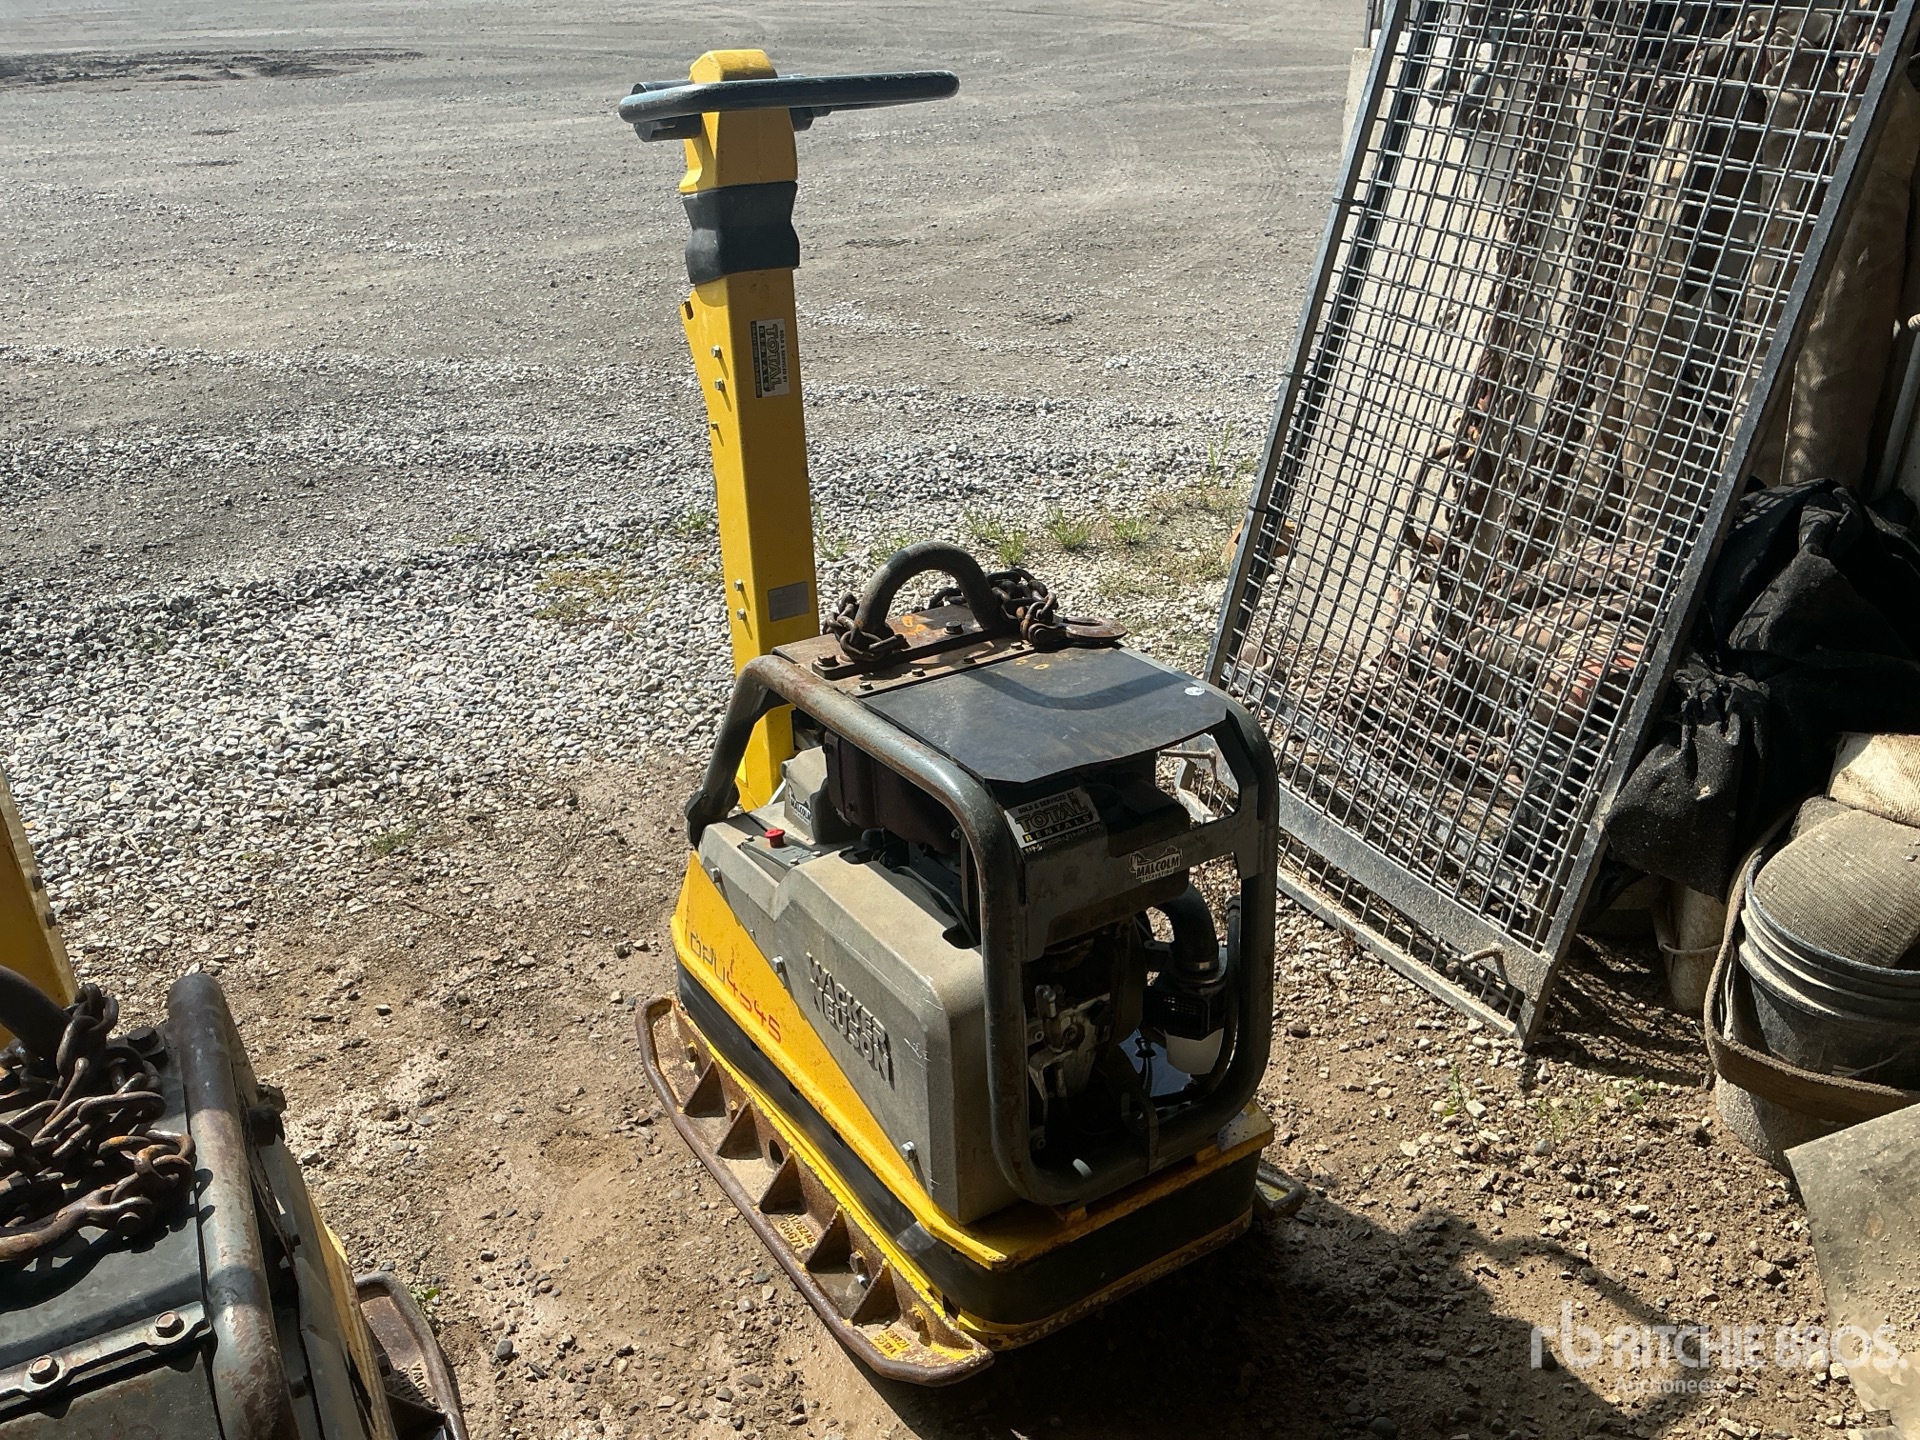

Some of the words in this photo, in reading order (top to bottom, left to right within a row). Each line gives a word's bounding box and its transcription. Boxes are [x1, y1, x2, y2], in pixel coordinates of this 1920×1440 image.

[759, 326, 769, 389] RENTALS
[766, 324, 782, 391] TOTAL
[1015, 795, 1089, 833] TOTAL
[1018, 804, 1033, 814] SOLD
[1024, 814, 1091, 842] RENTALS
[1136, 856, 1180, 878] MALCOLM
[806, 951, 891, 1054] WACKER
[810, 978, 893, 1083] NEUSON
